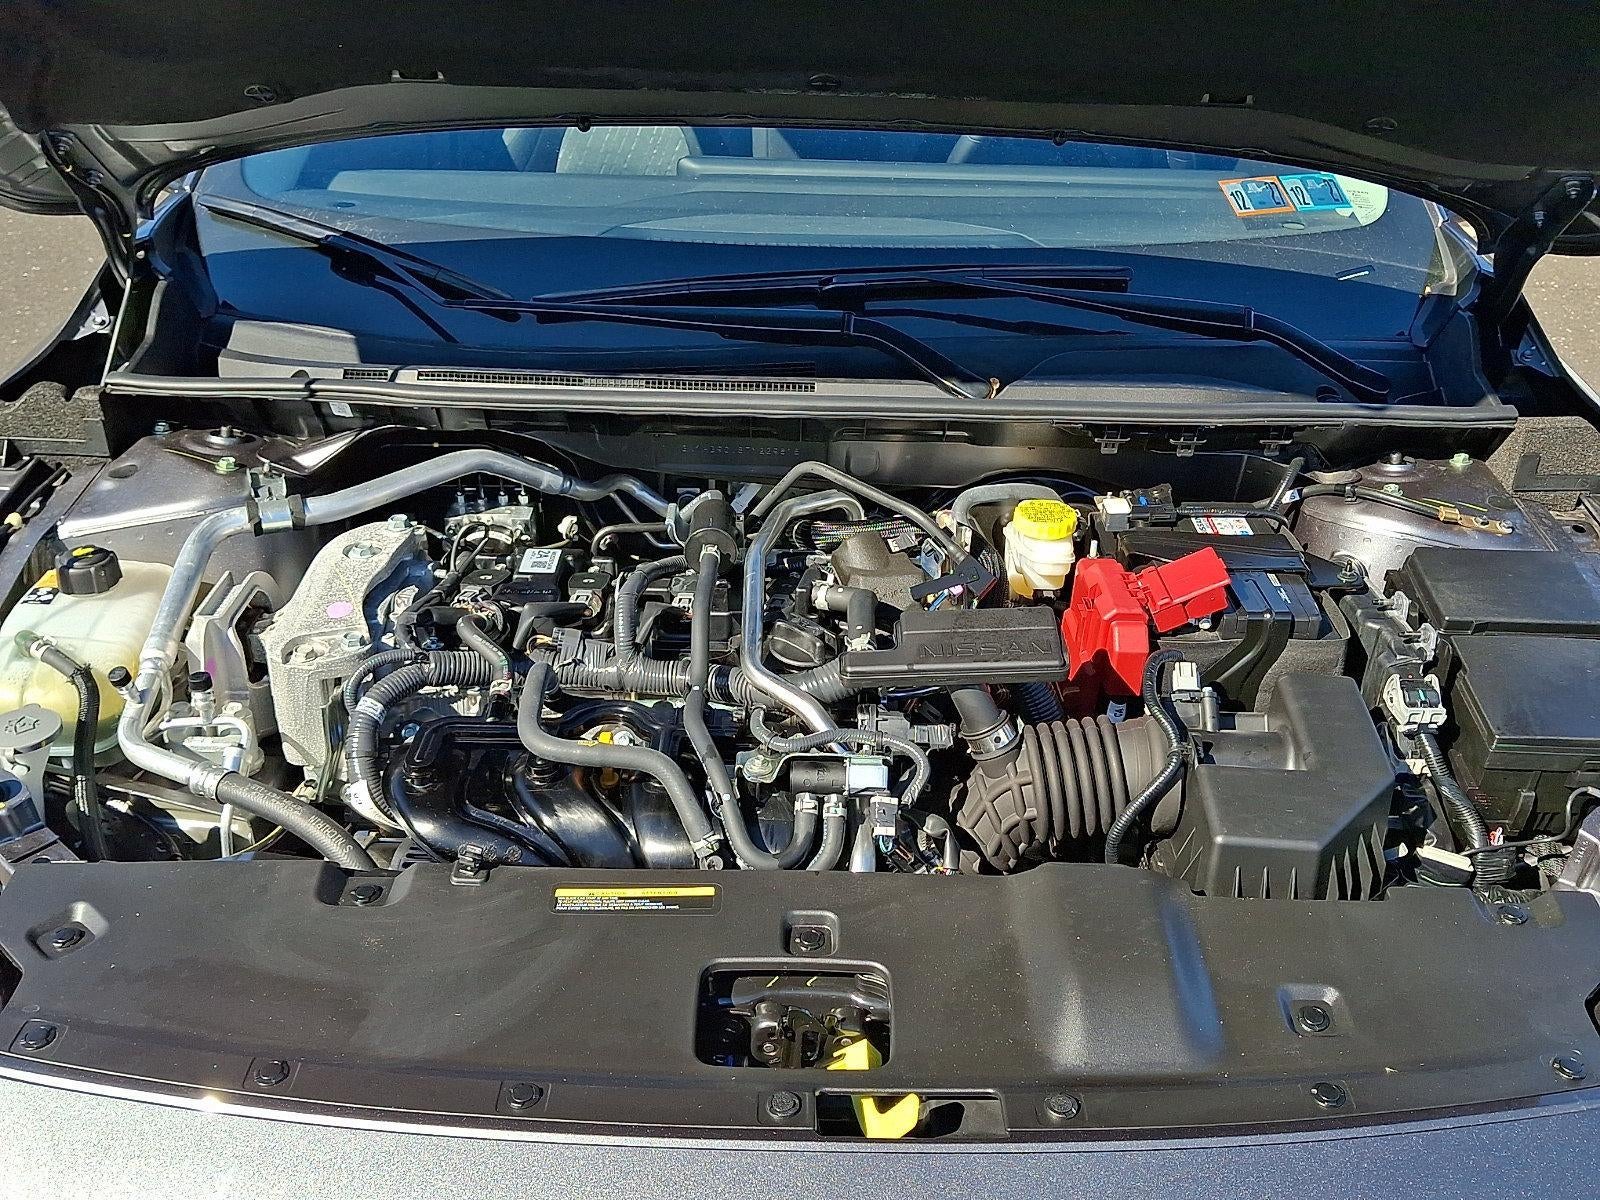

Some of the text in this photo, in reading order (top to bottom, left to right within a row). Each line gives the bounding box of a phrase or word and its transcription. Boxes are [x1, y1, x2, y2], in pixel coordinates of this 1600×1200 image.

[1230, 190, 1251, 211] 12
[1290, 185, 1311, 206] 12
[920, 642, 1053, 658] NISSAN
[308, 814, 346, 846] NICHIRIN
